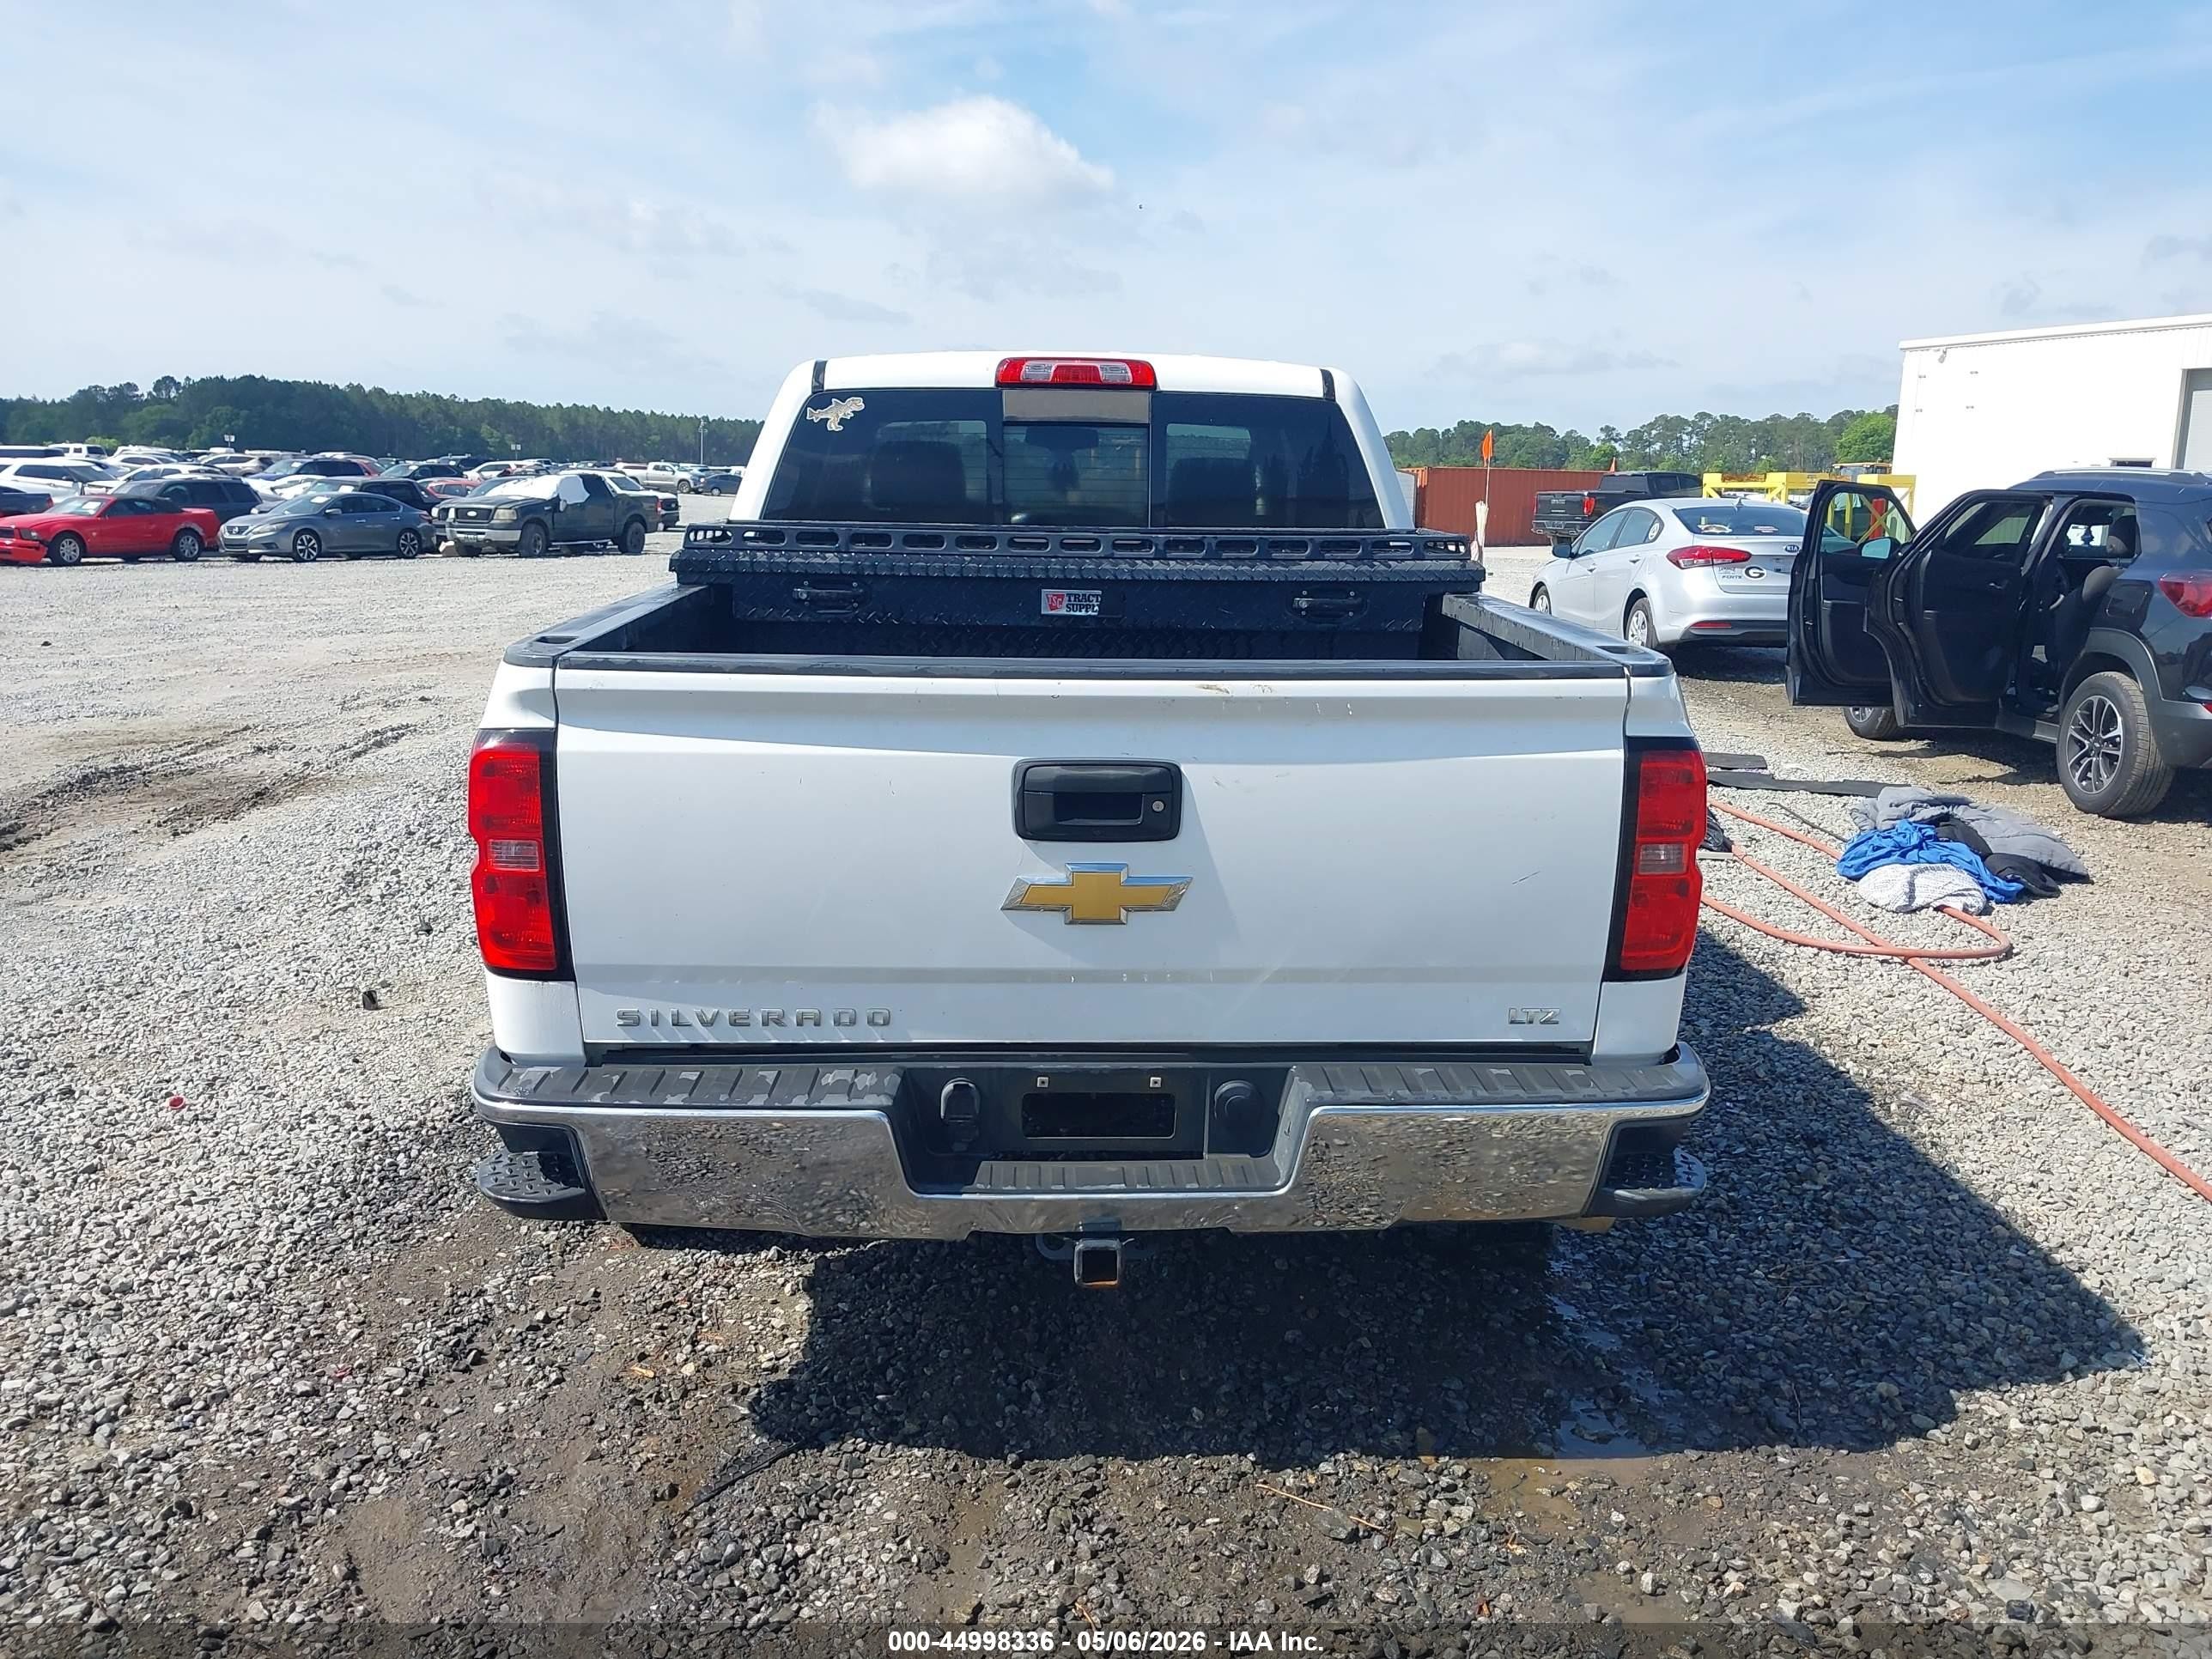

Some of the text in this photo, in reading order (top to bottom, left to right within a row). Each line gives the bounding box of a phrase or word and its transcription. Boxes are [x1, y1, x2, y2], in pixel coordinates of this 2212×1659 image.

[1744, 566, 1765, 579] G
[616, 1008, 891, 1027] SILVERADO
[1508, 1007, 1560, 1024] LTZ
